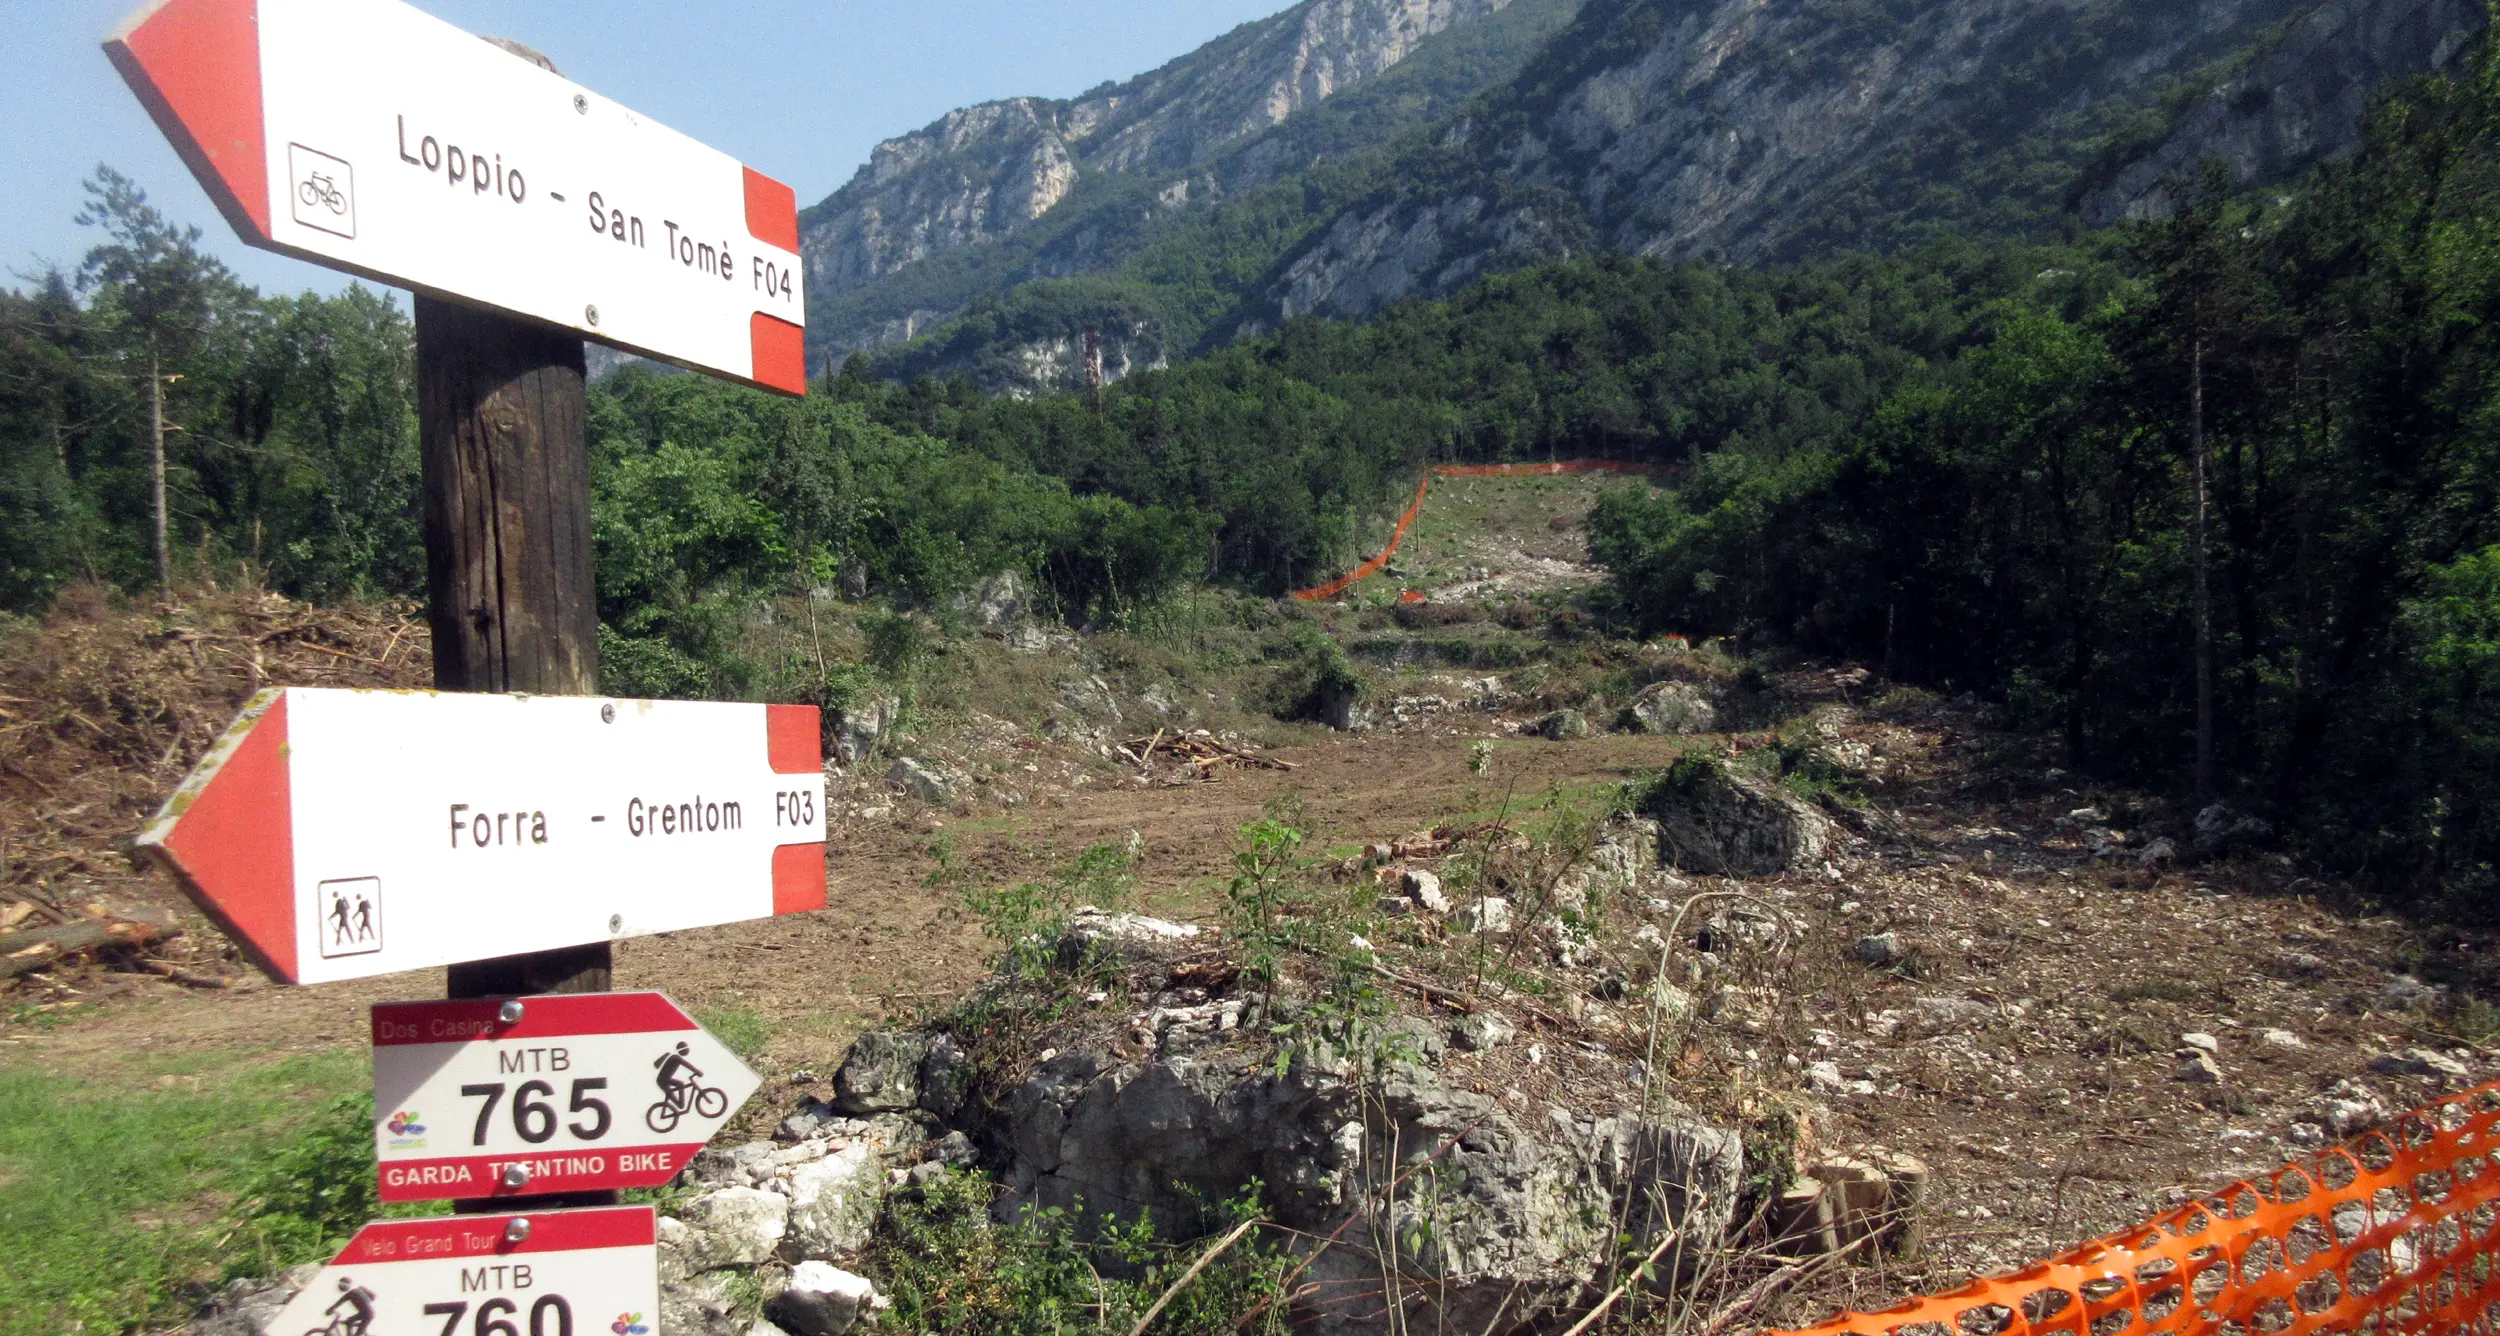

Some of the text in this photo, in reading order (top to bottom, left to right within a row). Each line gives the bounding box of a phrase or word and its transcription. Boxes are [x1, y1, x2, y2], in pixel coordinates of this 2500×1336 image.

[397, 113, 733, 281] Loppio - San Tomè
[753, 255, 793, 303] F04
[450, 794, 742, 849] Forra - Grentom
[776, 790, 814, 827] F03
[380, 1019, 495, 1039] Dos Casina
[499, 1046, 571, 1074] MTB
[460, 1076, 612, 1146] 765
[387, 1152, 672, 1187] GARDA TENTINO BIKE
[361, 1232, 496, 1256] Velo Grand Tour
[460, 1264, 533, 1293] MTB
[423, 1293, 574, 1336] 760
